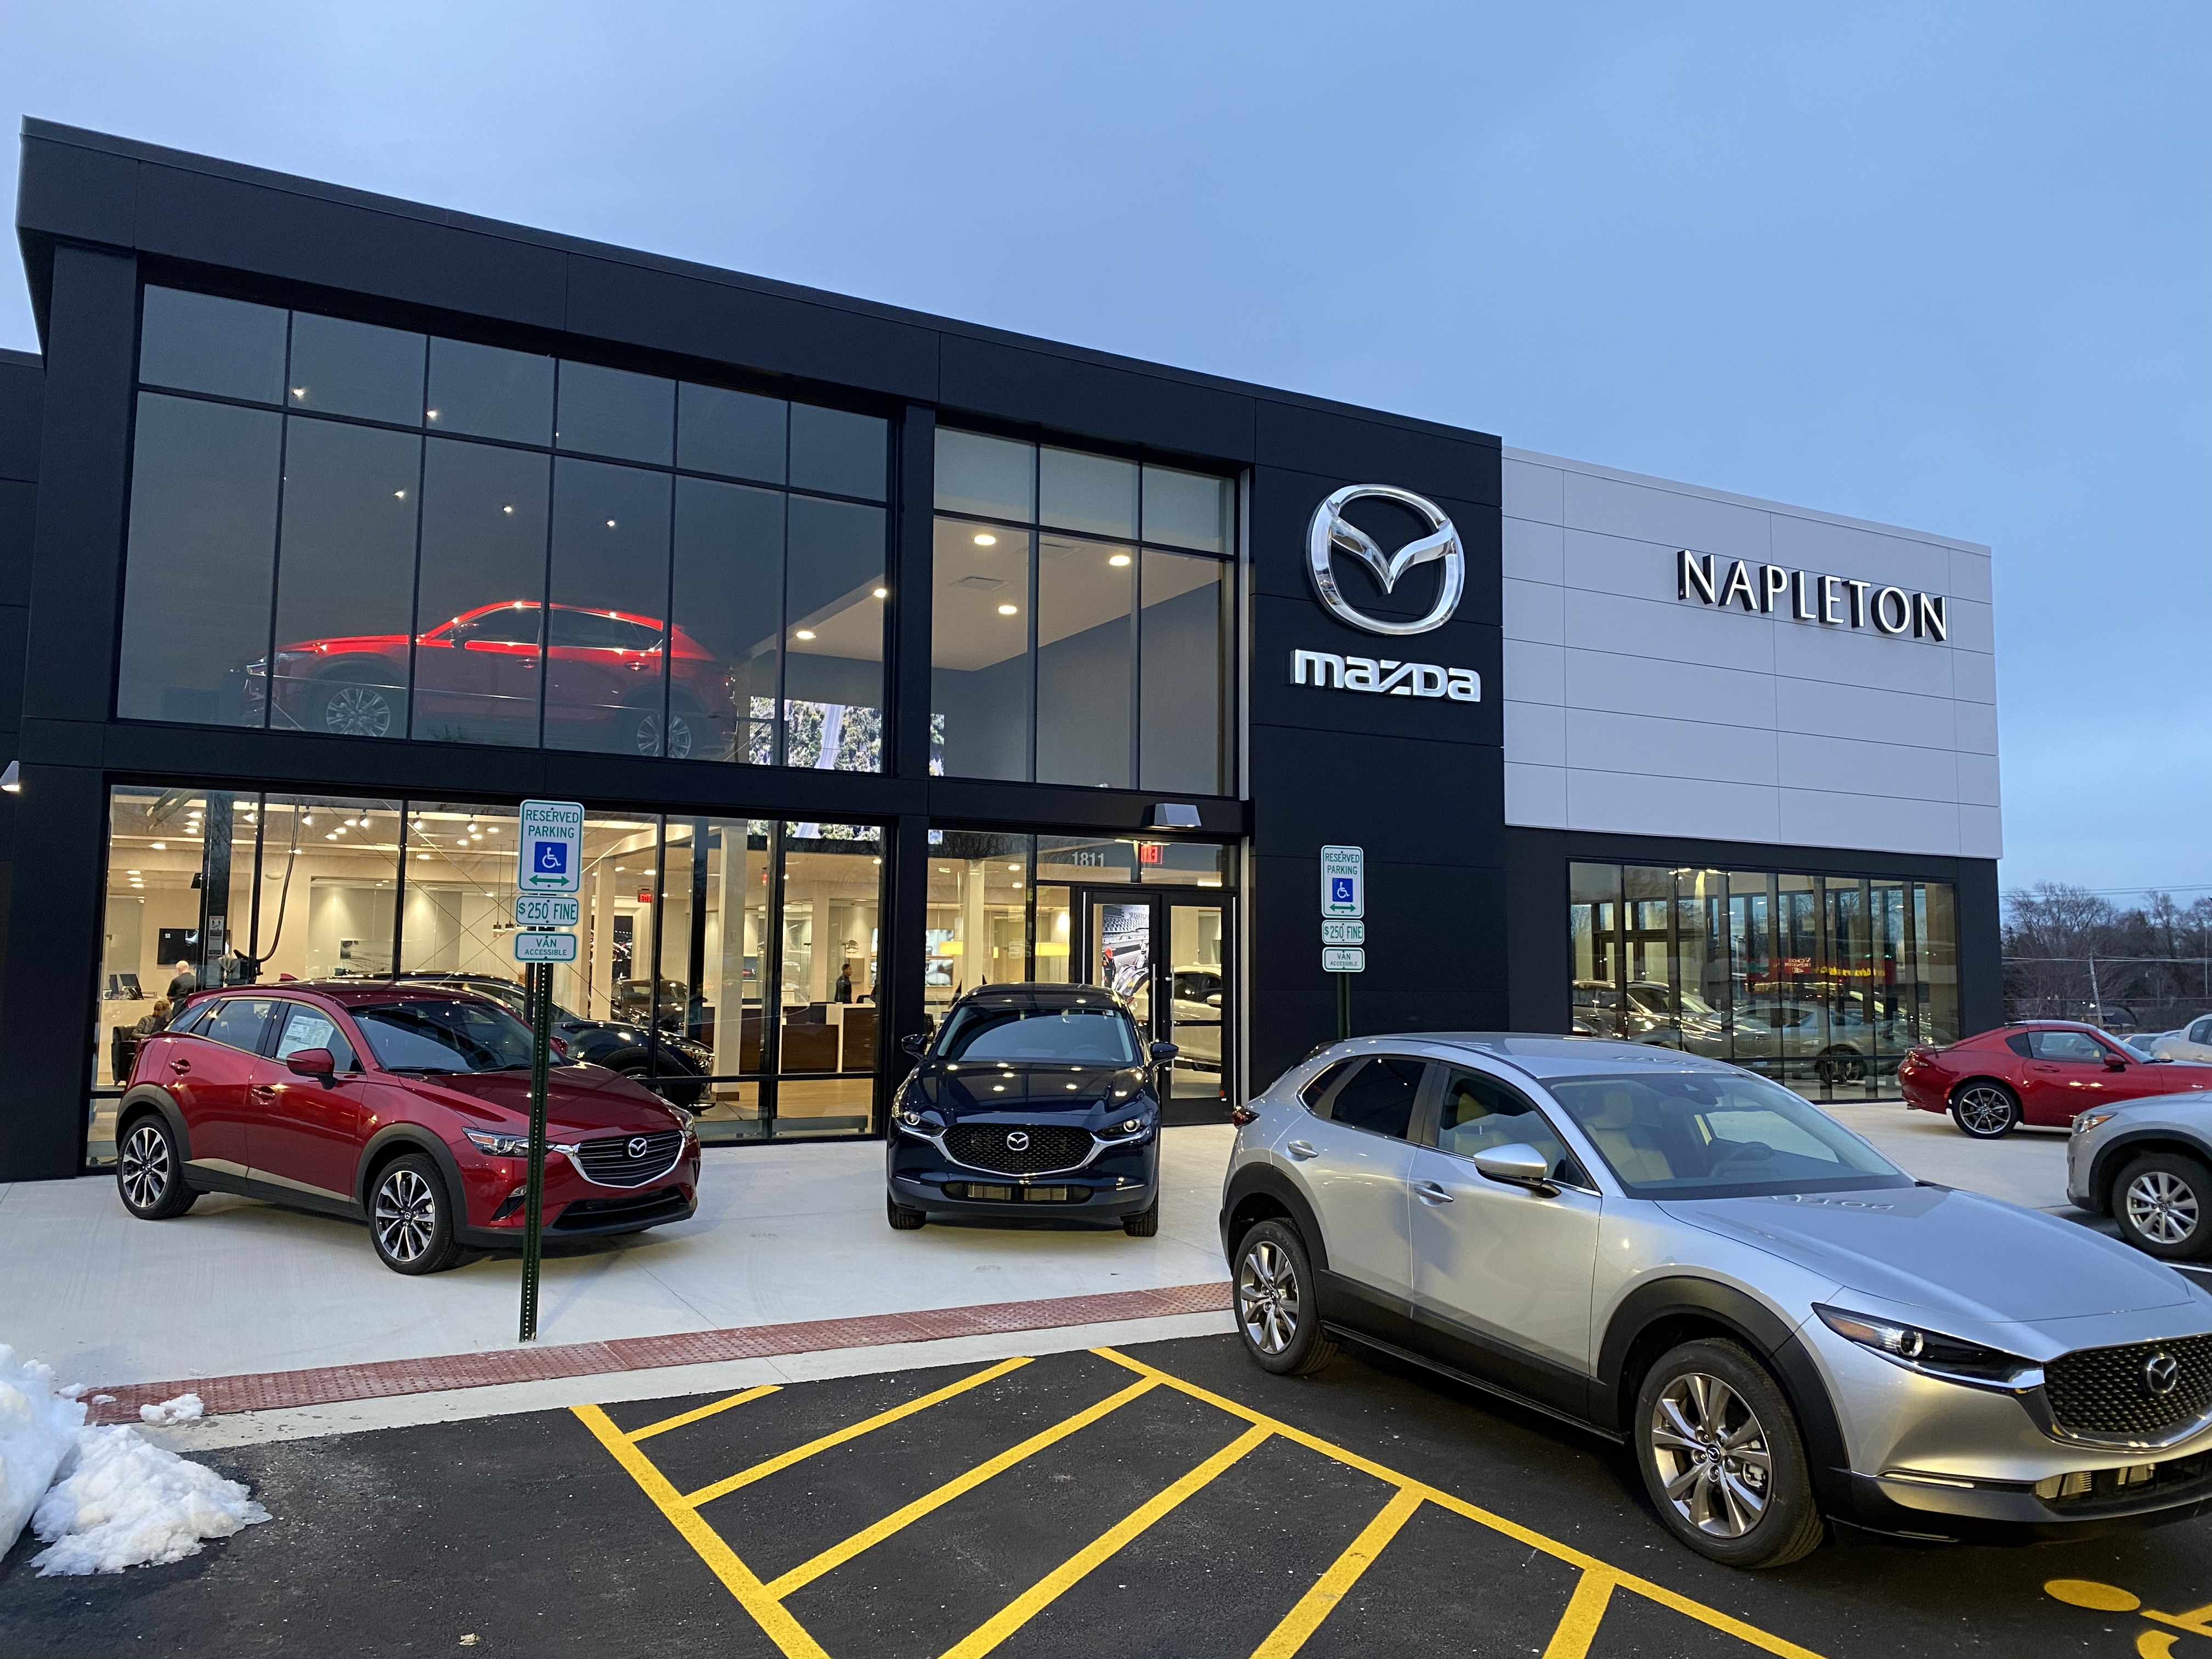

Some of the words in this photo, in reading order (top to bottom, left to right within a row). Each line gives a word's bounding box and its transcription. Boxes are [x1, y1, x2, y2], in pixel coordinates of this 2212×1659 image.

[1677, 549, 1947, 642] NAPLETON
[526, 810, 579, 823] RESERVED
[528, 825, 575, 838] PARKING
[1071, 851, 1104, 867] 1811
[1325, 853, 1360, 863] RESERVED
[1327, 865, 1358, 875] PARKING
[518, 902, 548, 919] $250
[554, 903, 577, 920] FINE
[1324, 926, 1344, 939] $250
[1347, 926, 1362, 939] FINE
[536, 939, 557, 947] VAN
